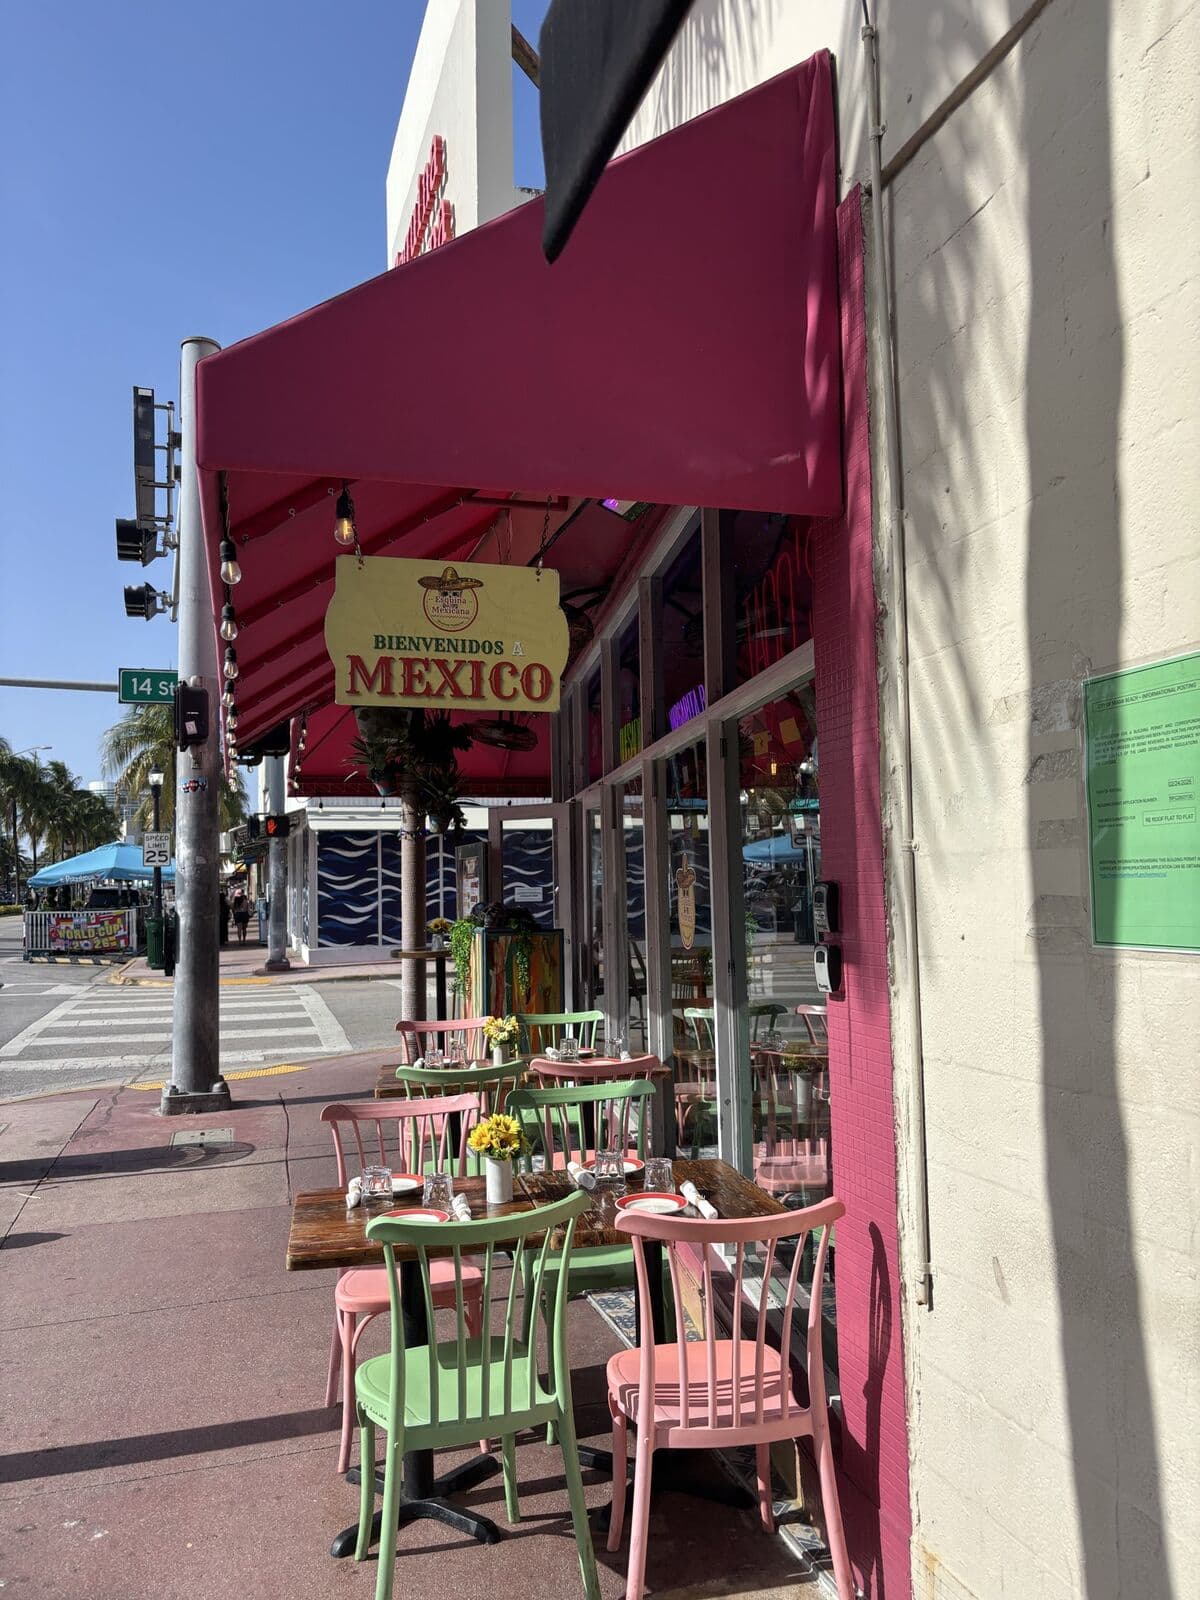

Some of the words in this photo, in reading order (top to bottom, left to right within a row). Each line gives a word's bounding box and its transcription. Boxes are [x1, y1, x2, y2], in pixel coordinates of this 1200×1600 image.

[373, 634, 505, 656] BIENVENIDOS
[511, 640, 526, 657] A
[345, 654, 554, 703] MEXICO
[131, 677, 153, 696] 14
[158, 680, 176, 697] St
[145, 834, 169, 842] SPEED
[145, 850, 169, 863] 25
[58, 928, 96, 939] WORLD
